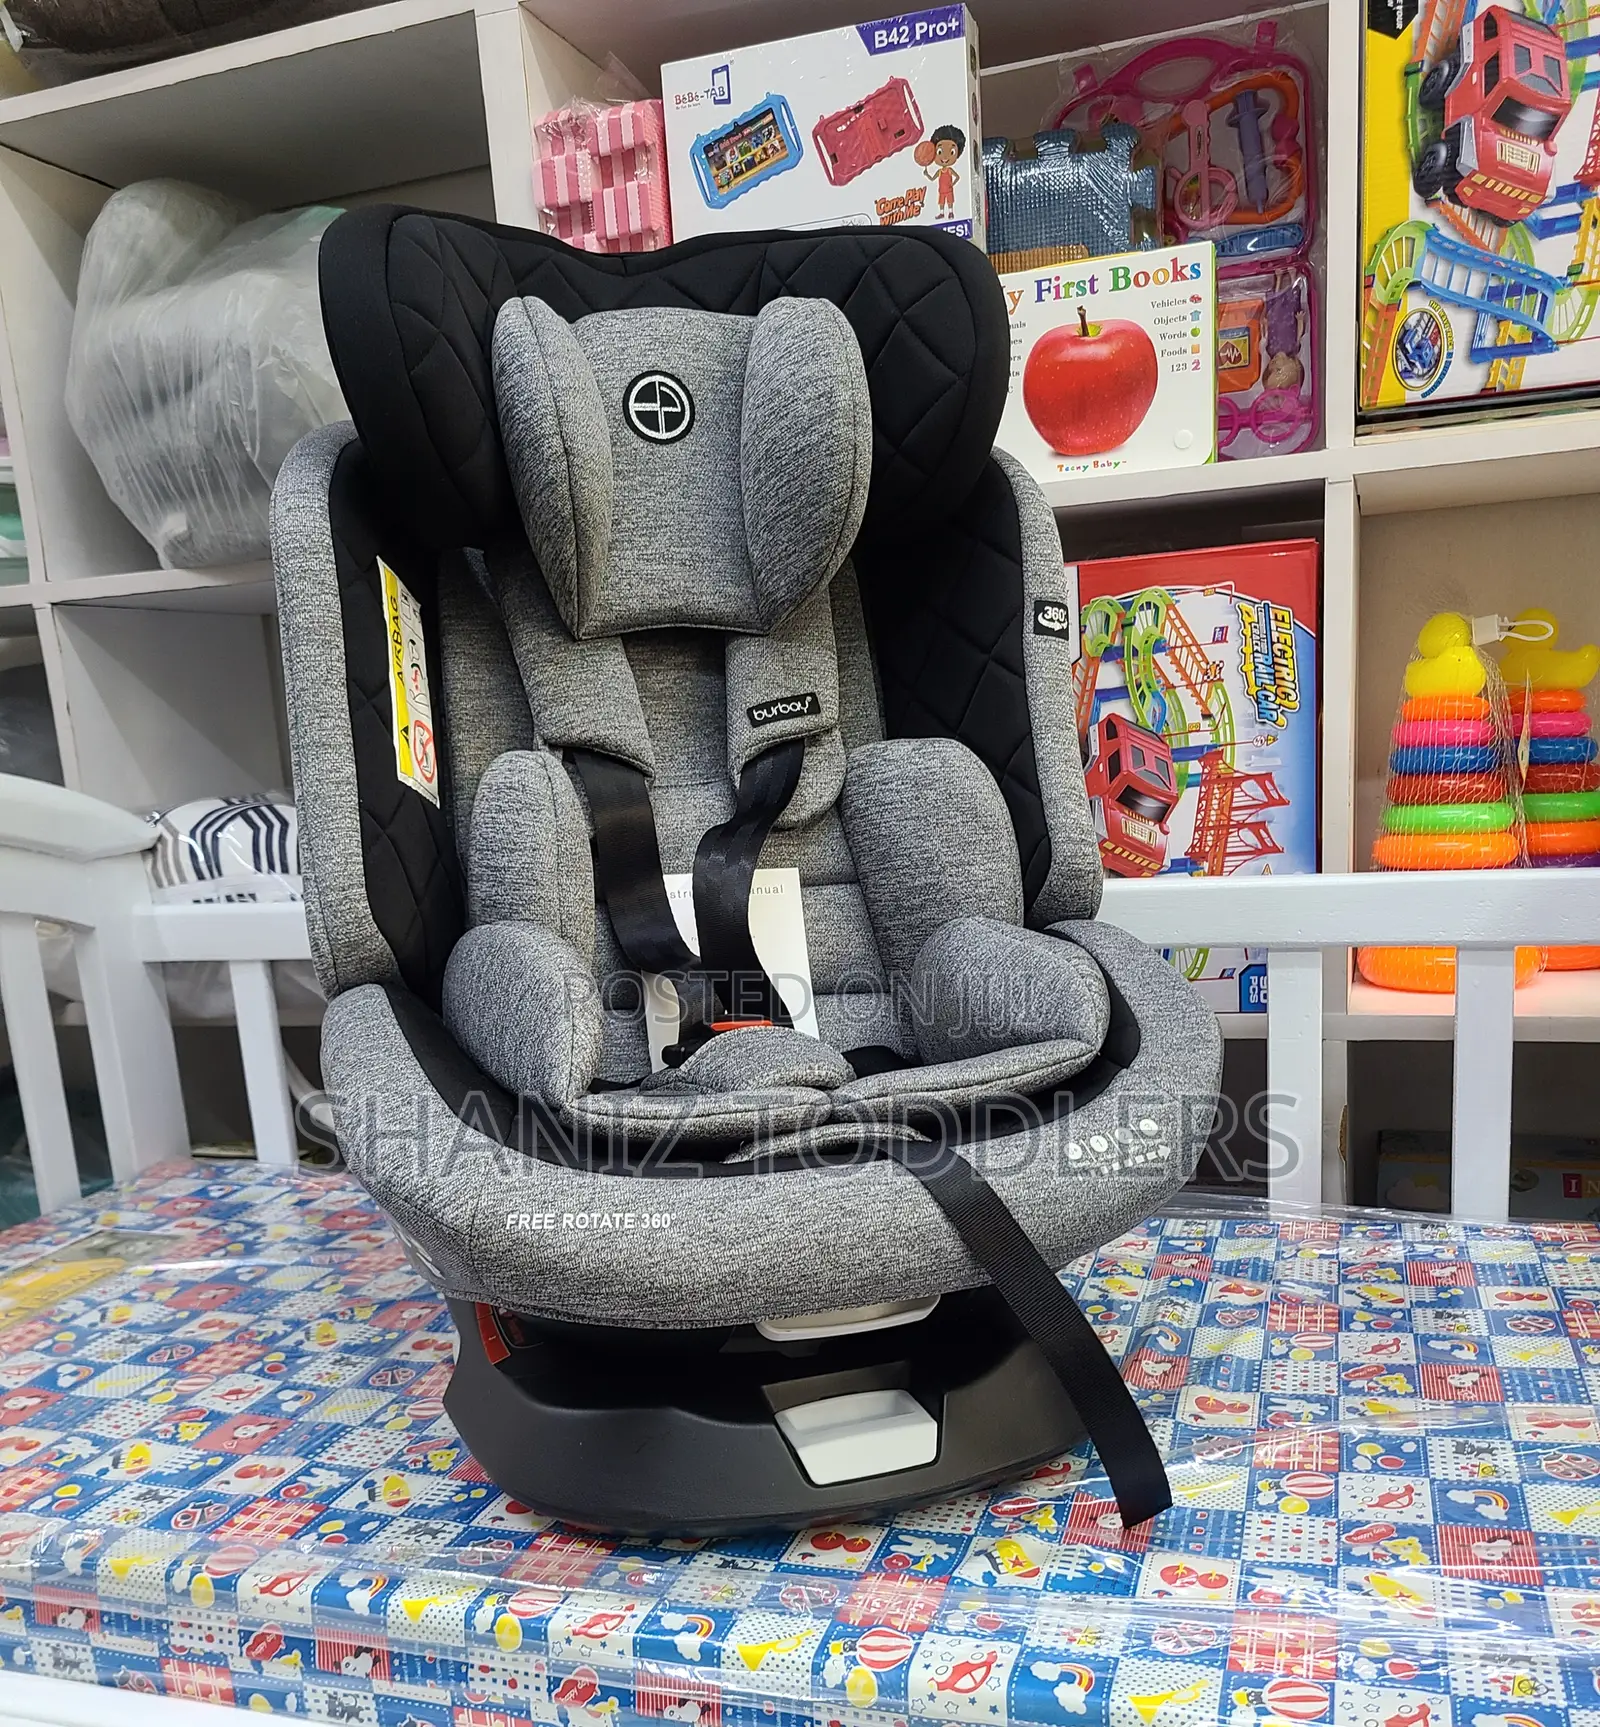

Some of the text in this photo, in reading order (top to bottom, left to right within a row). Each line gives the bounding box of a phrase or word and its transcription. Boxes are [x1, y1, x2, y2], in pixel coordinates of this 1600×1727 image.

[874, 17, 960, 48] B42 Pro+
[1002, 257, 1202, 315] y First Books
[1150, 297, 1188, 309] Vehicles
[1153, 315, 1188, 326] Objects
[1159, 330, 1188, 341] Words
[1160, 346, 1188, 358] Foods
[1170, 362, 1188, 373] 123
[1056, 460, 1121, 473] Teeny Baby
[390, 595, 406, 687] AIRBAG
[1270, 607, 1299, 703] ELECTRIC
[1253, 650, 1276, 687] RAIL
[753, 698, 810, 721] burbay
[1256, 689, 1281, 723] CAR
[1249, 975, 1259, 1004] PCS
[506, 1212, 677, 1230] FREE ROTATE 360°
